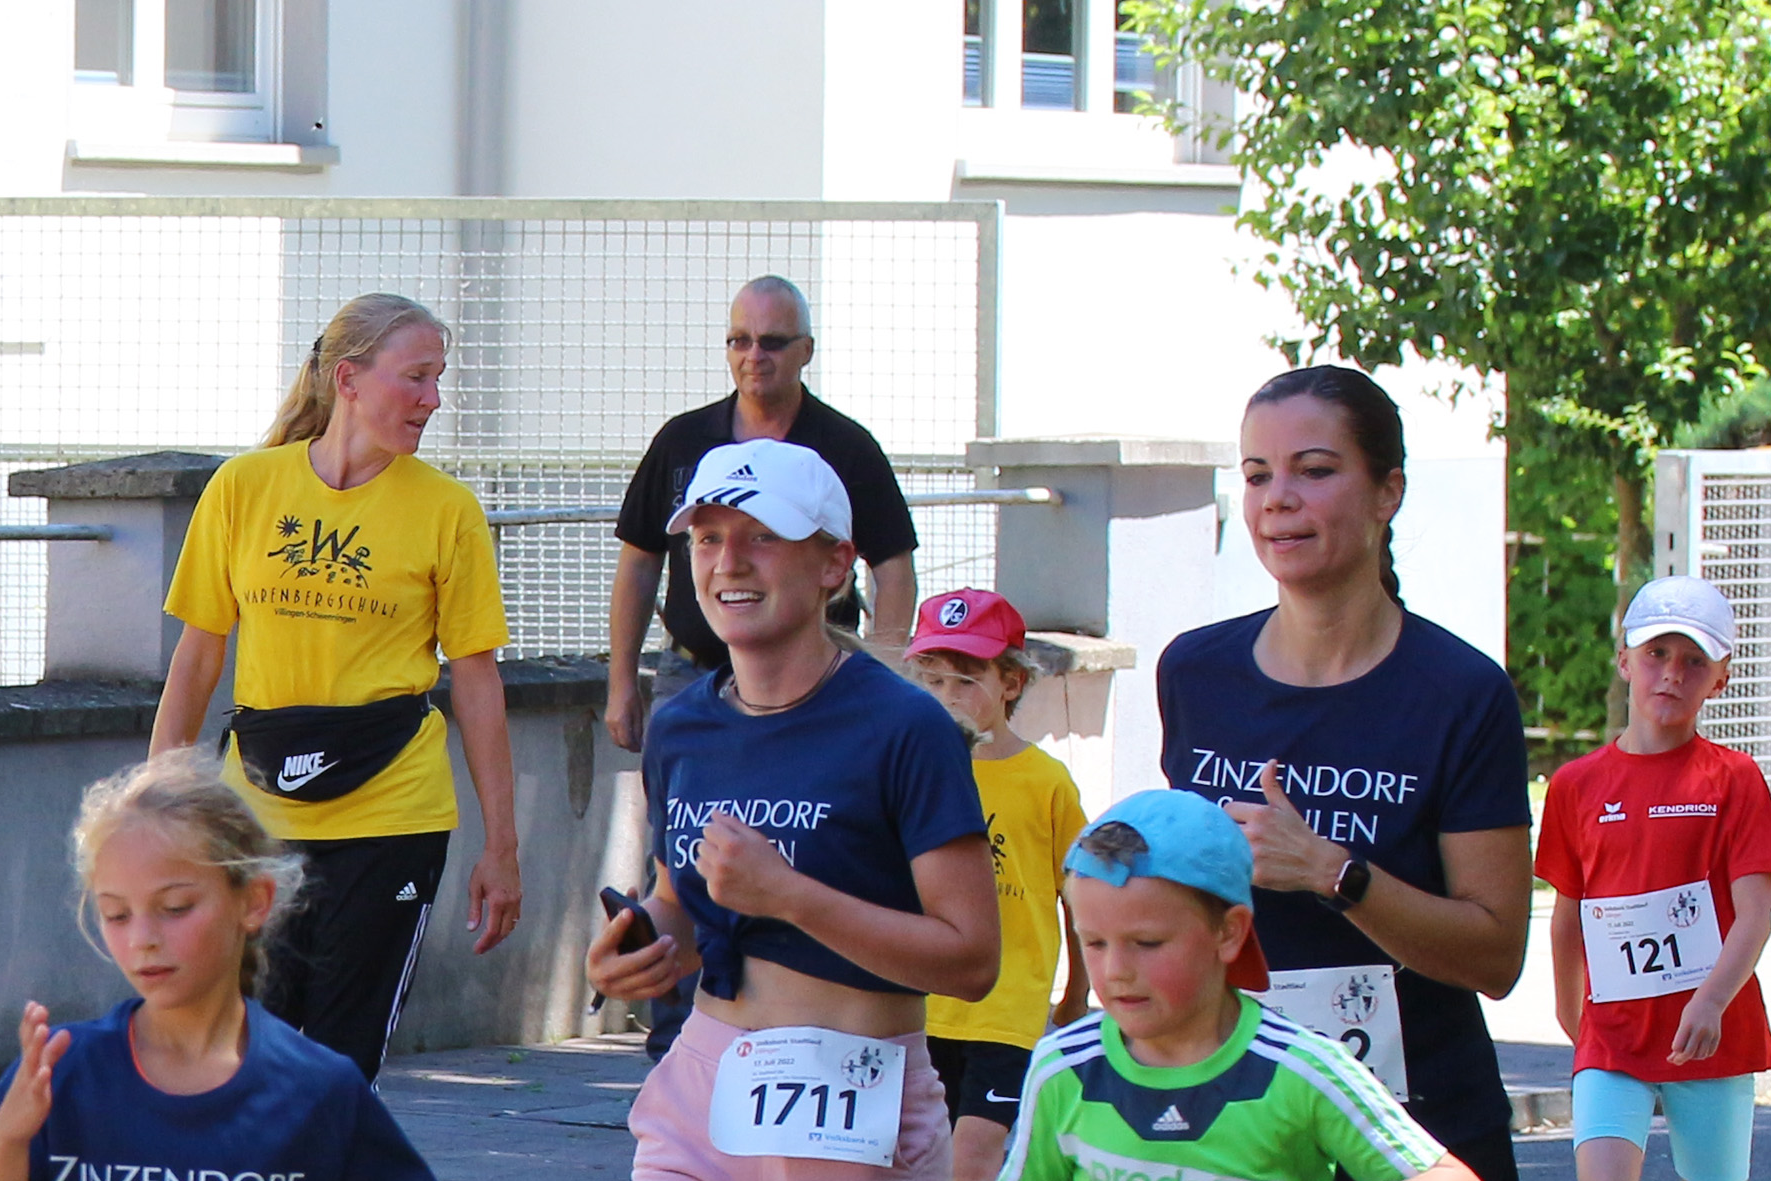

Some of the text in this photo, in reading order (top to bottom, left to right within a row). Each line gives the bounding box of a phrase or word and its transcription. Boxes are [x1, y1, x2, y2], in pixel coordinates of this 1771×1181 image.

[283, 751, 325, 777] NIKE
[1648, 804, 1717, 814] KENDRION
[1620, 933, 1681, 975] 121
[749, 1083, 858, 1131] 1711
[1152, 1121, 1190, 1131] adidas
